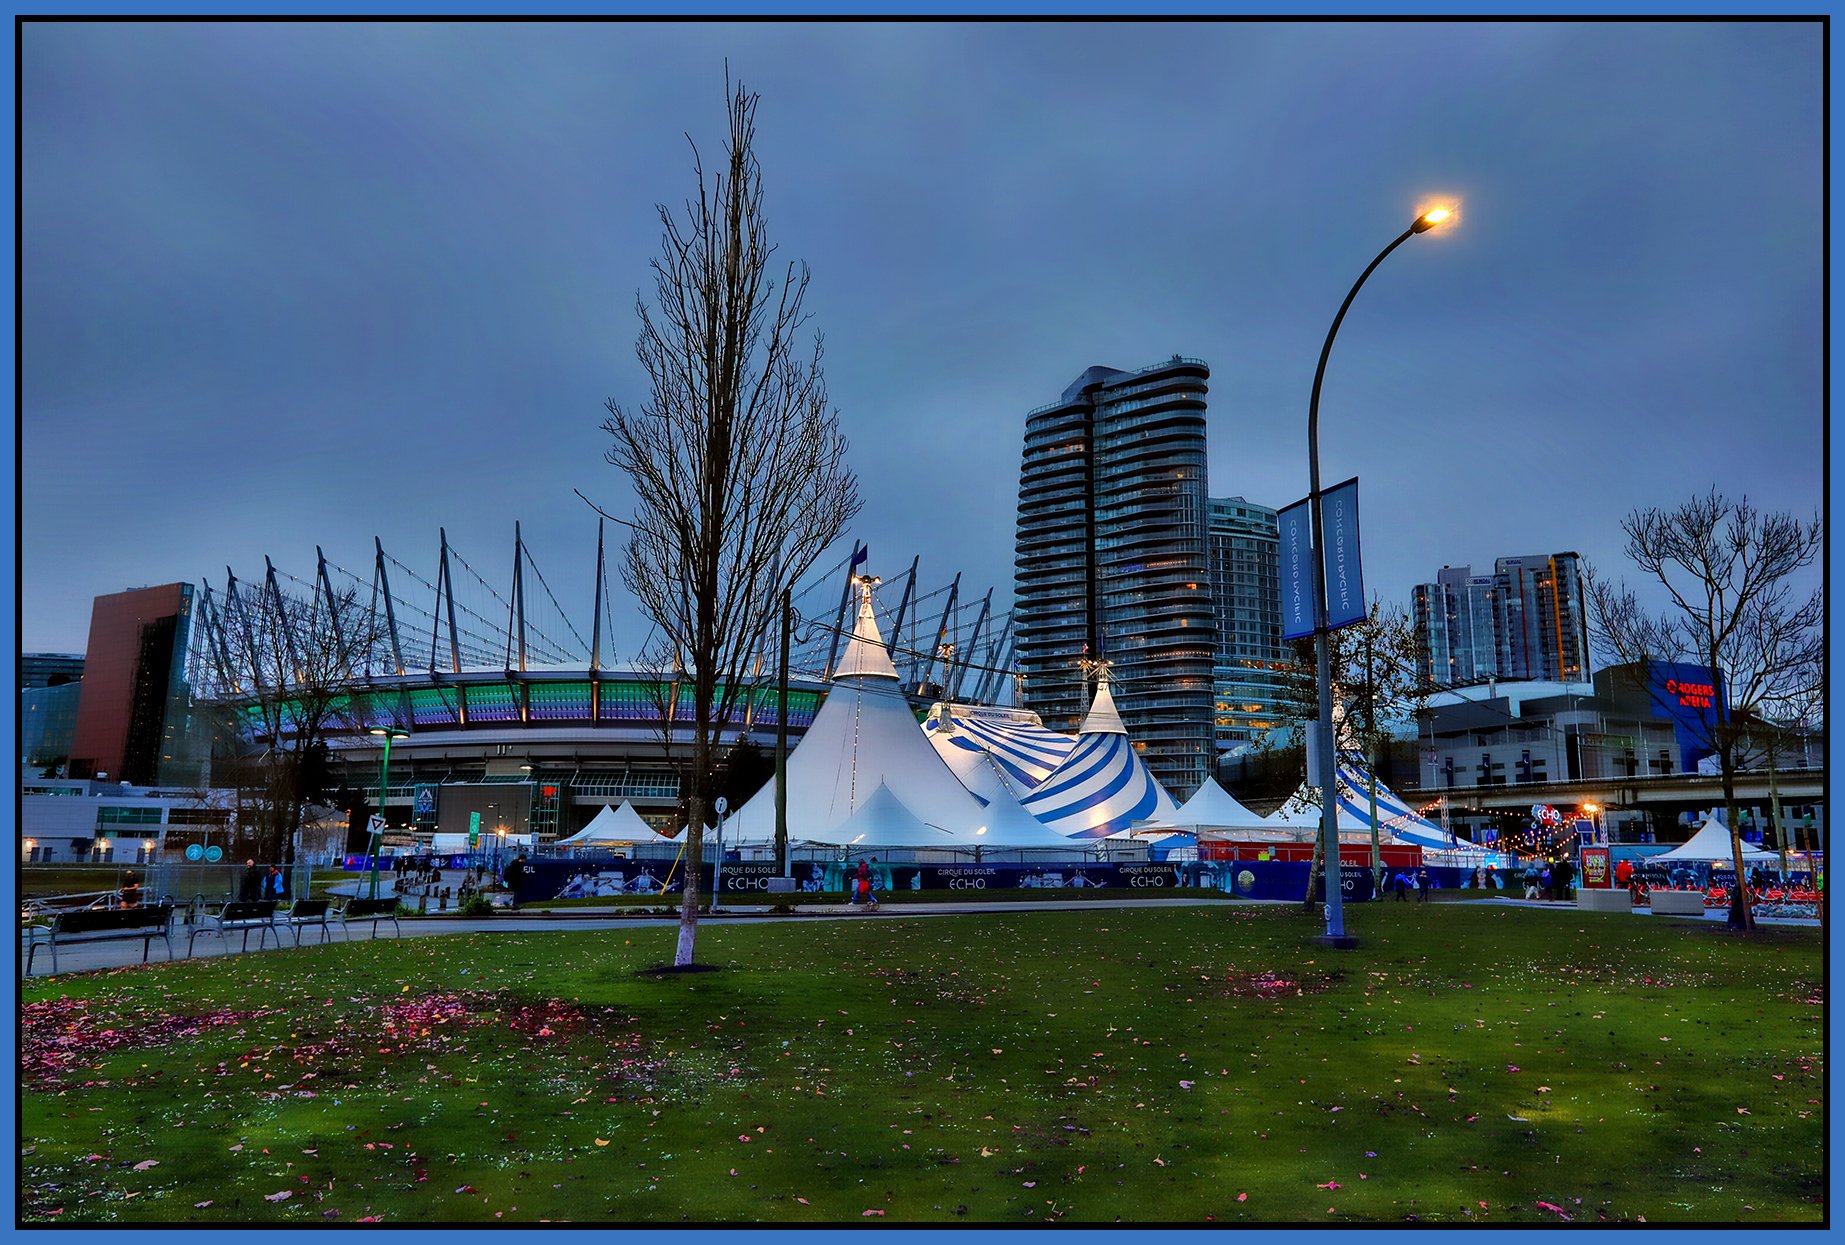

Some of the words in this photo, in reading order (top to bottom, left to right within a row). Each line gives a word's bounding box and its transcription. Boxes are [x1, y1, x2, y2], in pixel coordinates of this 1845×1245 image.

[1678, 682, 1714, 696] ROGERS
[1679, 695, 1711, 708] ARENA
[1538, 810, 1560, 820] ECHO
[720, 866, 744, 876] IRQUE
[744, 866, 756, 874] DU
[937, 868, 962, 877] CIRQUE
[1119, 867, 1143, 875] CIRQUE
[727, 877, 769, 890] ECHO
[949, 878, 986, 890] ECHO
[1130, 876, 1164, 887] ECHO
